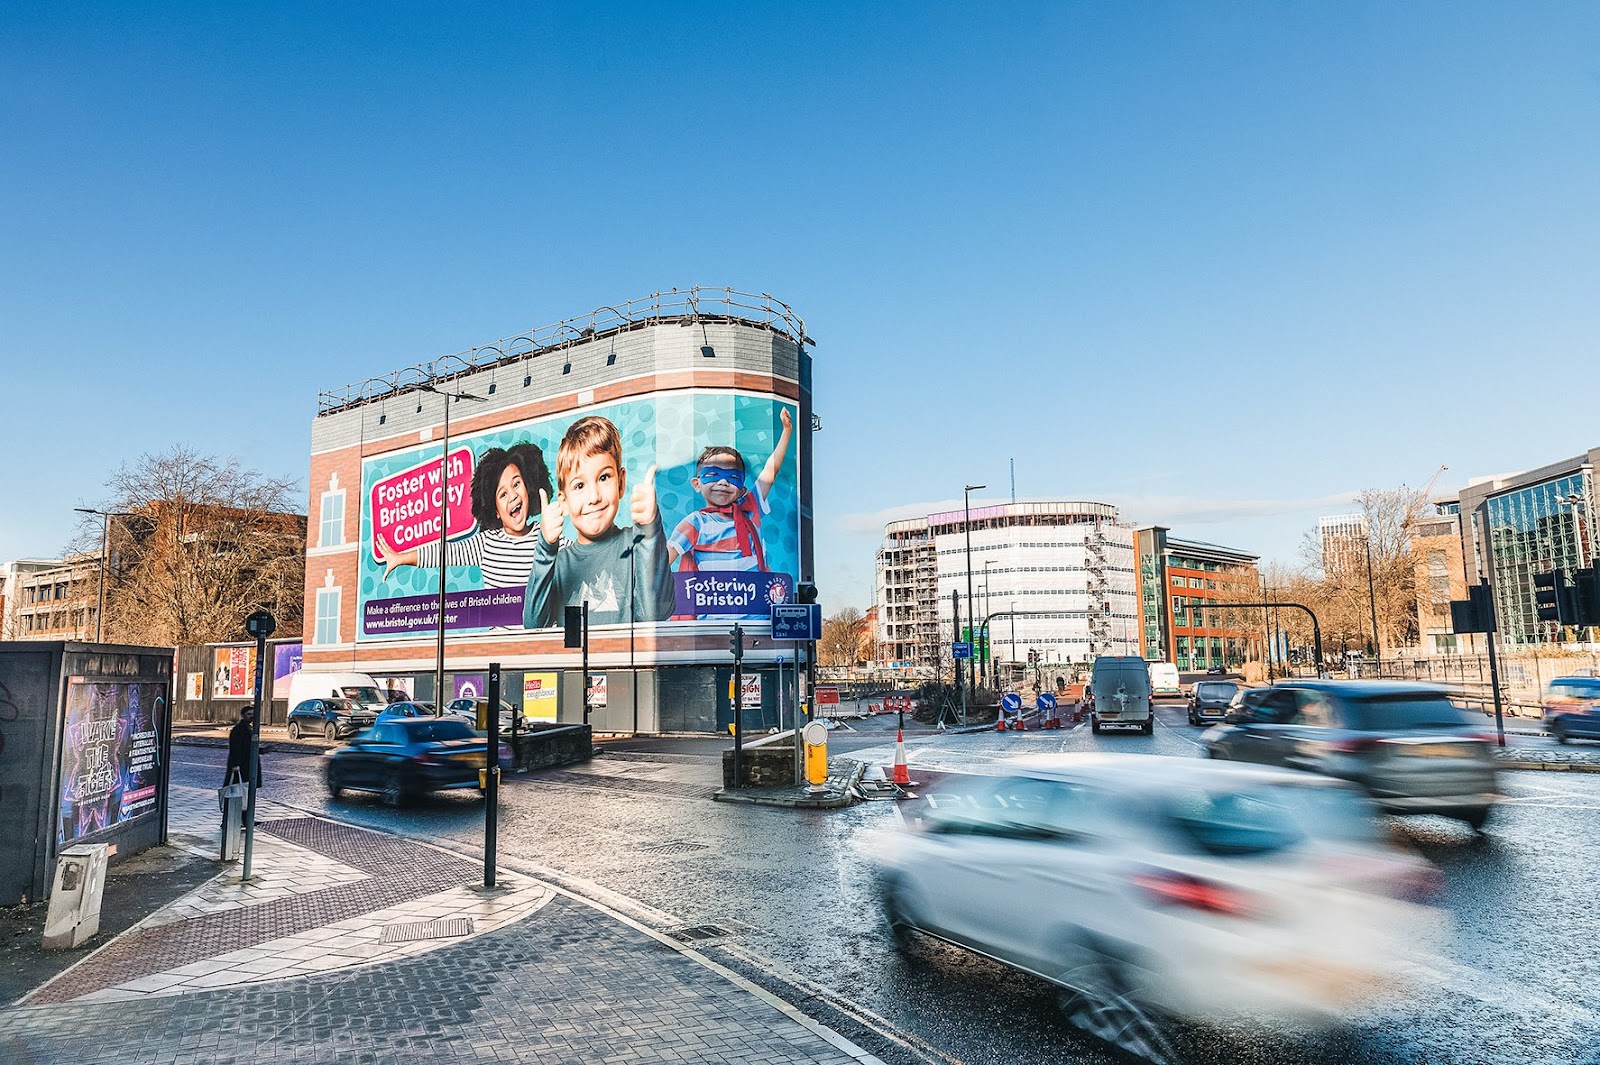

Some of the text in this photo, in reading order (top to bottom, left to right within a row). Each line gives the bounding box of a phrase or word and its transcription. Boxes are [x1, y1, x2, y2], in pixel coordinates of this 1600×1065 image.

[378, 456, 464, 505] Foster with
[380, 482, 464, 528] Bristol Cty
[394, 508, 450, 544] Councl
[684, 576, 756, 600] Fostering
[696, 592, 748, 606] Bristol
[366, 606, 384, 616] Make
[389, 602, 421, 613] difference
[422, 603, 430, 611] to
[443, 599, 458, 609] ives
[459, 597, 468, 608] of
[468, 595, 491, 606] Bristol
[492, 594, 522, 604] children
[492, 673, 498, 681] 2
[526, 681, 541, 690] Hello
[80, 718, 117, 745] WAKE
[85, 744, 108, 769] THE
